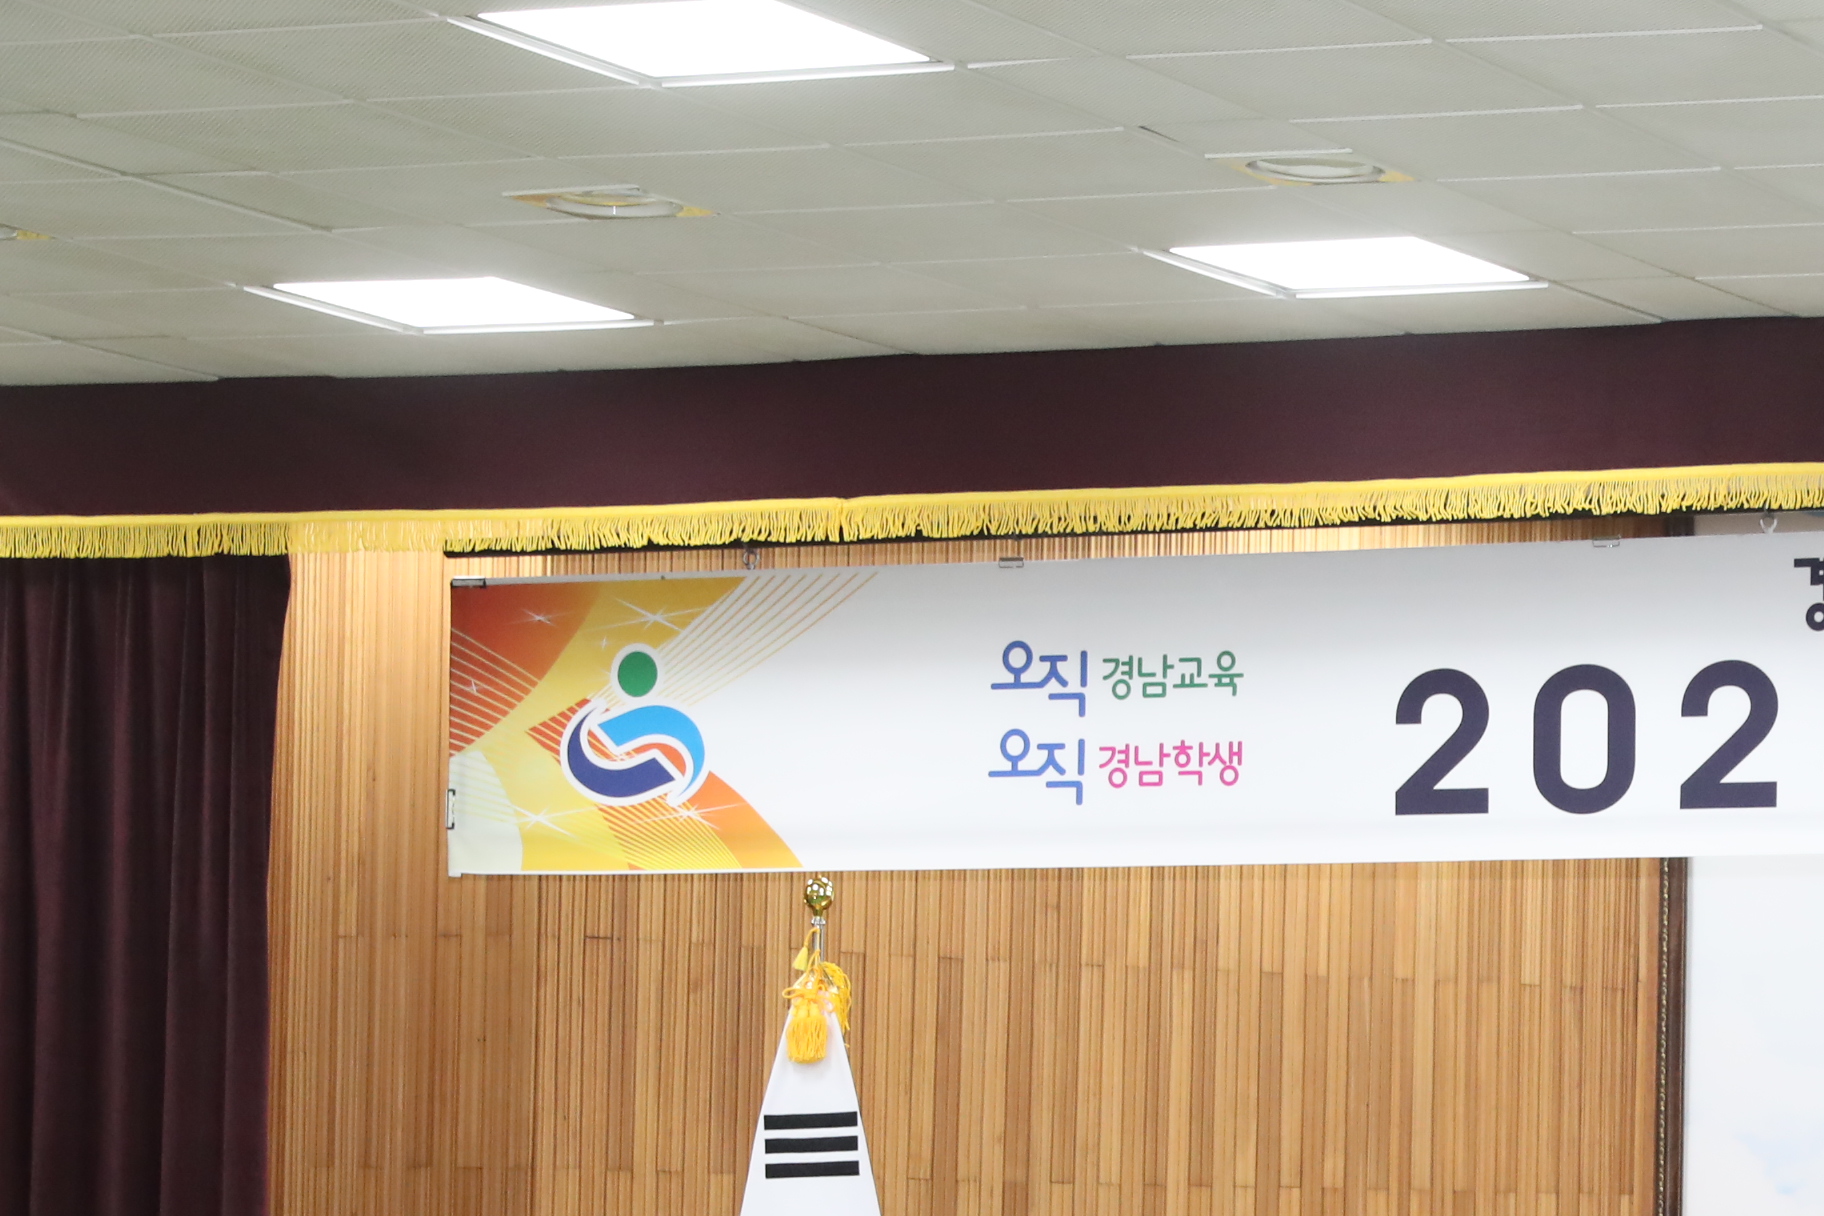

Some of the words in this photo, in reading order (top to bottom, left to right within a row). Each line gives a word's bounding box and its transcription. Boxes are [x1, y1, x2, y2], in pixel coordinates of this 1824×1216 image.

[990, 639, 1088, 717] 오직
[1101, 649, 1244, 697] 경남교육
[987, 728, 1086, 806] 오직
[1097, 738, 1244, 789] 경남학생
